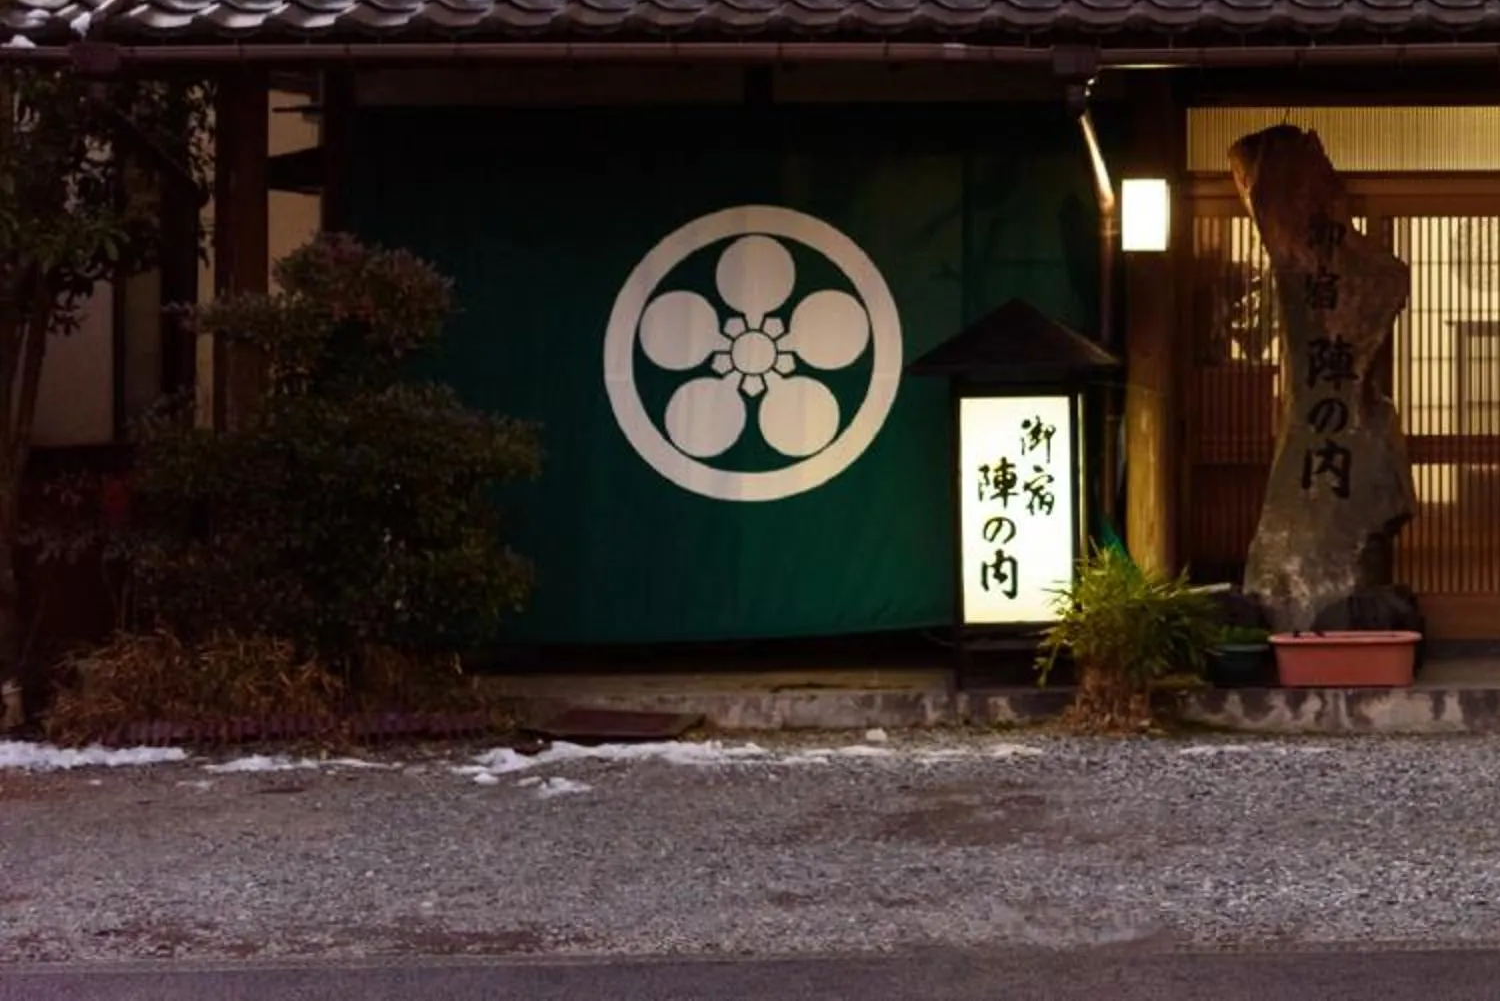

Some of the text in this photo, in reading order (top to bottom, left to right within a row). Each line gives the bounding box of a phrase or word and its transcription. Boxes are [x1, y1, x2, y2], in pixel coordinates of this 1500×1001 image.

[1020, 415, 1056, 516] 御宿
[1302, 336, 1359, 498] 陣の内
[978, 456, 1018, 600] 陣の内
